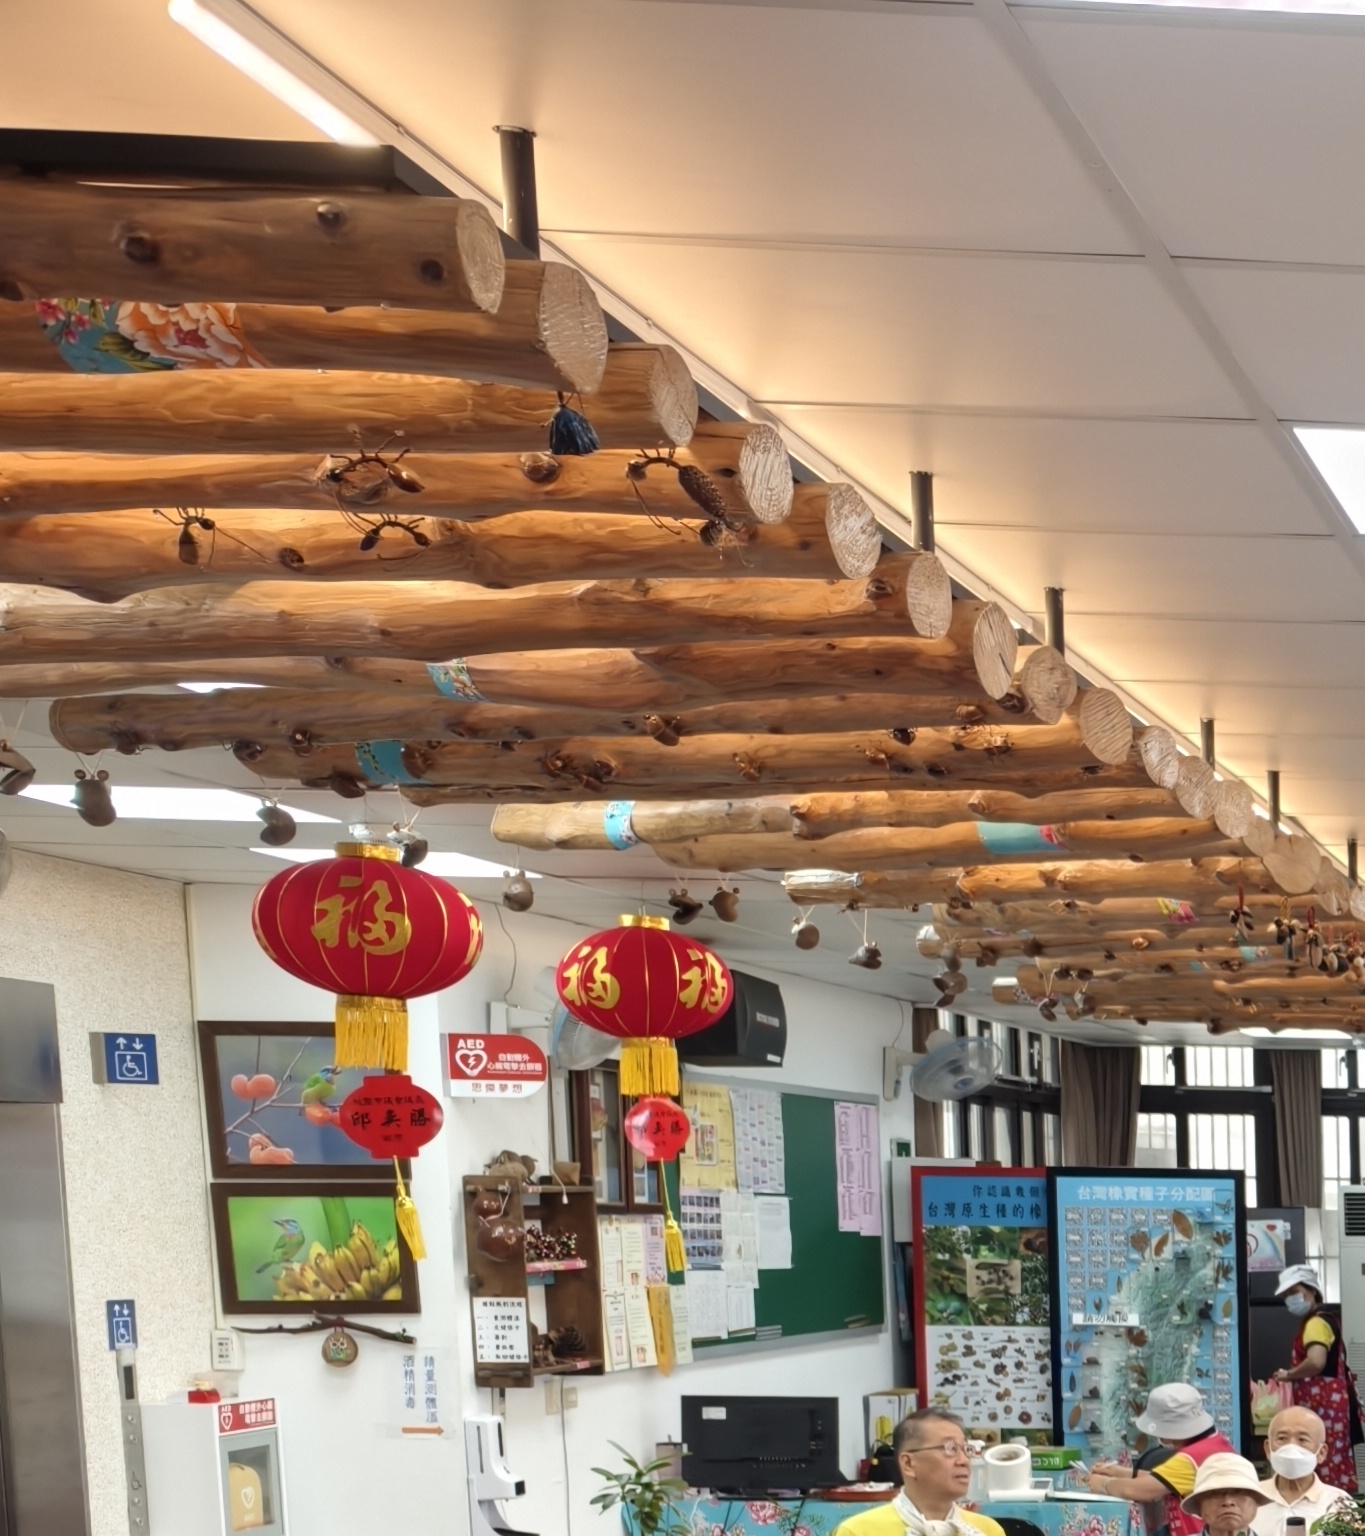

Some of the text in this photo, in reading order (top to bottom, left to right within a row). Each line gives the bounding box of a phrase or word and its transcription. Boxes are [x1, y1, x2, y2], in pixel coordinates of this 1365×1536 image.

[311, 875, 411, 956] 福
[562, 945, 621, 1010] 福
[457, 1038, 485, 1049] AED
